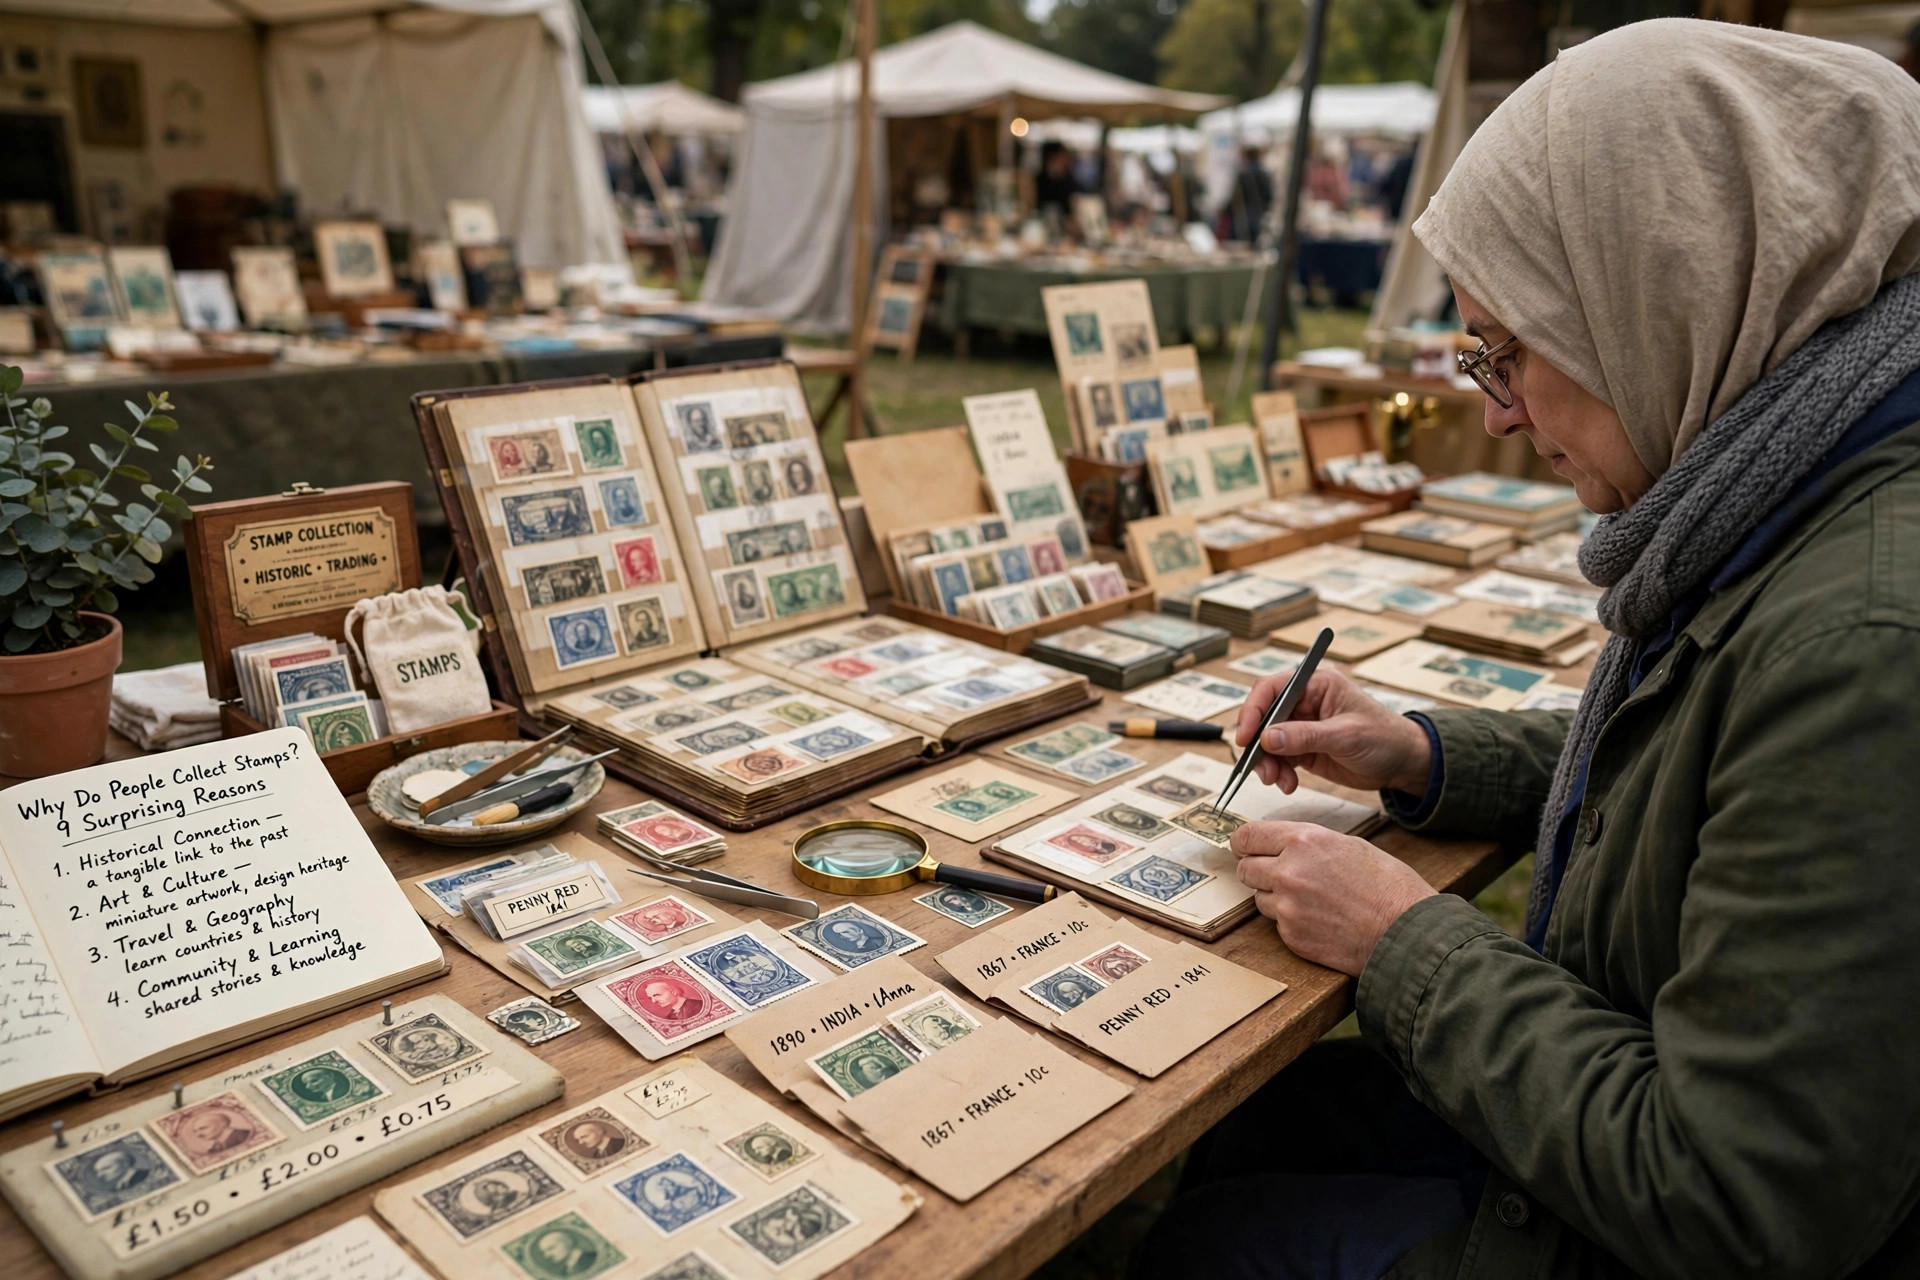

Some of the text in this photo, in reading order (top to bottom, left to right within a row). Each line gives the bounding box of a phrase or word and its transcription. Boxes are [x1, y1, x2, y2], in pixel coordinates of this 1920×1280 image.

[250, 531, 293, 550] STAMP
[298, 521, 373, 541] COLLECTION
[256, 564, 312, 584] HISTORIC
[327, 553, 377, 572] TRADING
[397, 652, 461, 682] STAMPS
[18, 742, 300, 821] Why Do People Collect Stamps?
[57, 777, 267, 838] 9 Surprising Reasons
[53, 862, 69, 878] 1.
[79, 836, 164, 872] Historical
[174, 816, 260, 846] Connection
[87, 826, 289, 889] a tangible link to the past
[69, 905, 89, 921] 2.
[98, 892, 129, 912] Art
[142, 884, 153, 898] &
[163, 867, 228, 894] Culture
[105, 854, 350, 931] miniature artwork, design heritage
[508, 884, 579, 914] PENNY RED
[88, 894, 295, 964] 3. Travel & Geography
[124, 906, 320, 974] learn countries & history
[976, 921, 1089, 980] 1867 FRANCE 10c
[108, 927, 341, 1007] 4. Community & Learning
[144, 939, 367, 1019] shared stories & knowledge
[770, 1029, 806, 1056] 1890
[820, 1003, 862, 1032] INDIA
[1099, 964, 1212, 1037] PENNY RED 1841
[920, 1065, 1050, 1148] 1867 FRANCE 10c
[127, 1094, 451, 1250] £1.50 £2.00 £0.75
